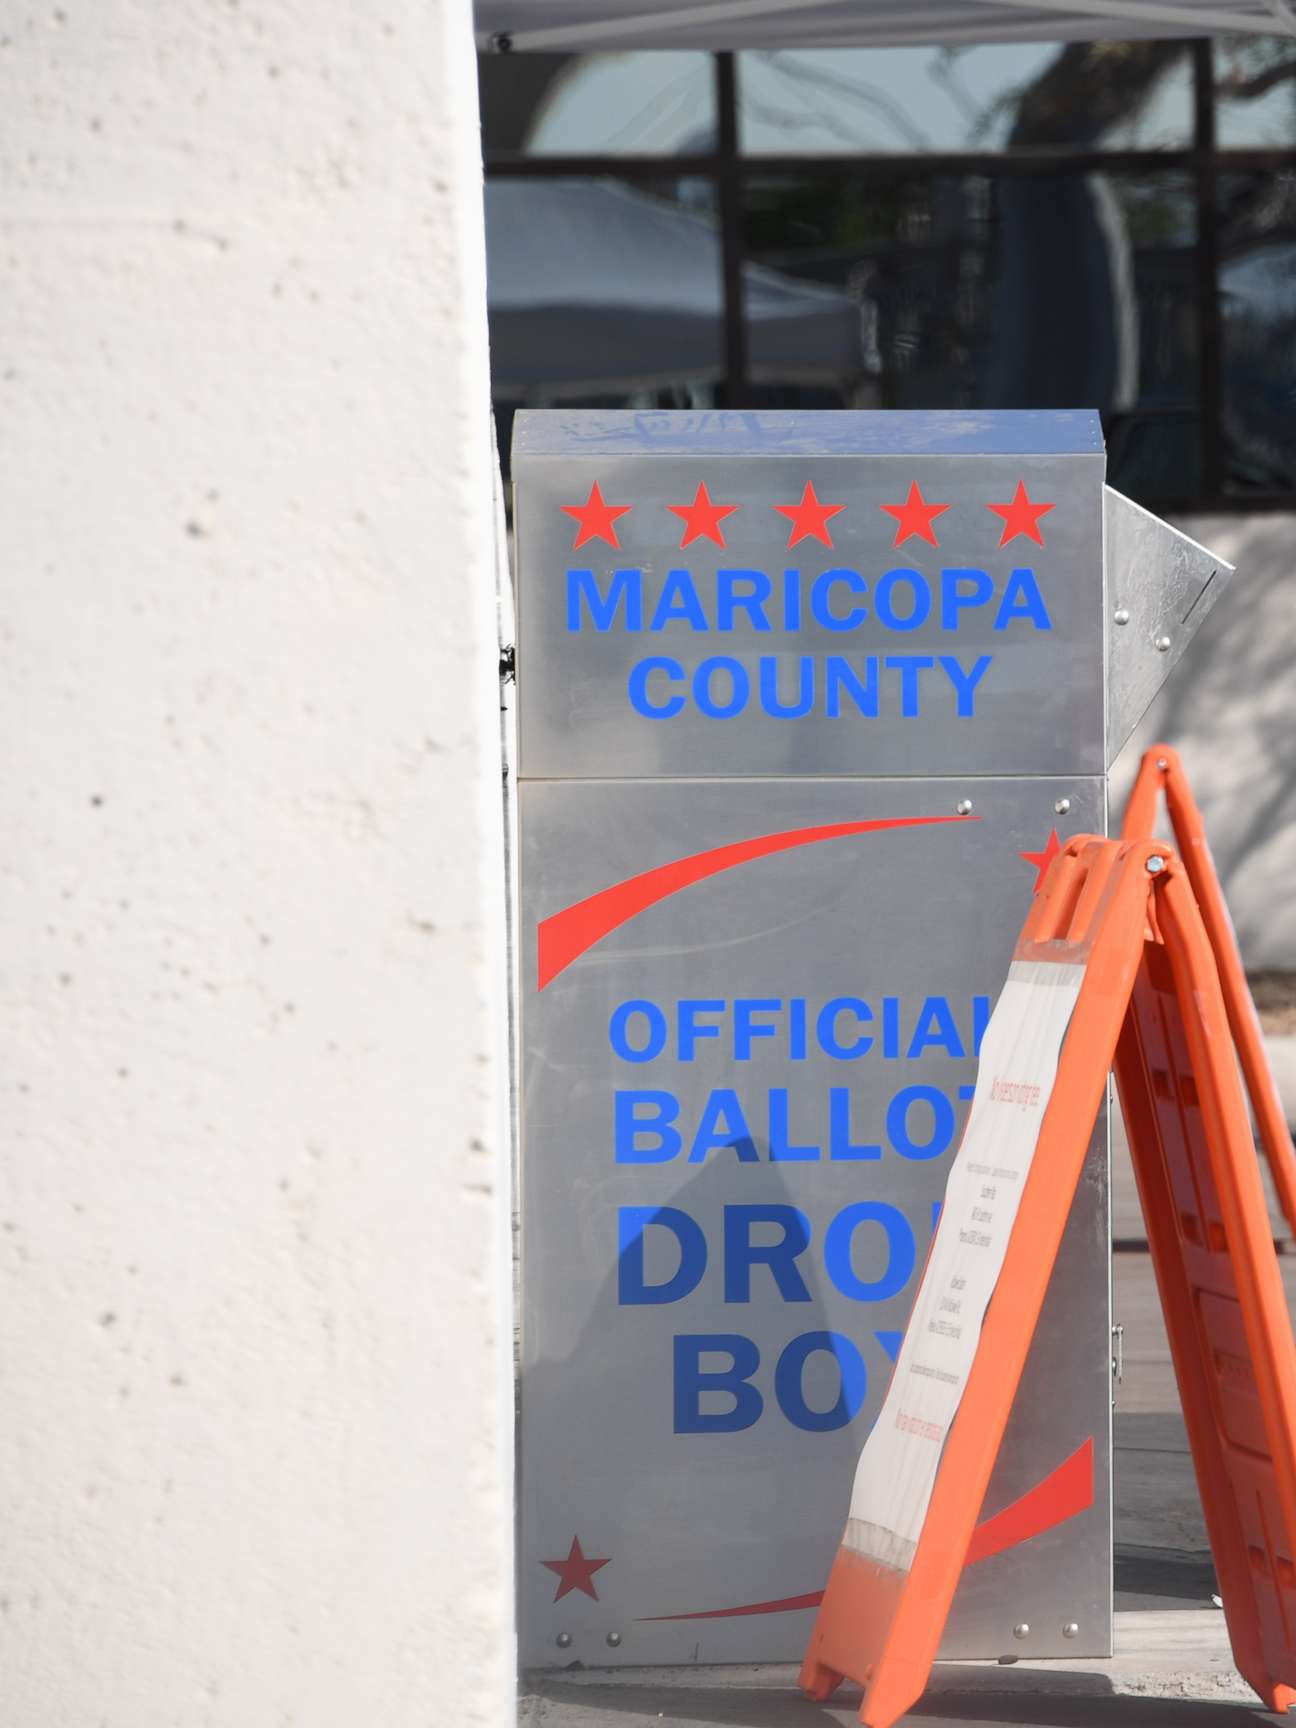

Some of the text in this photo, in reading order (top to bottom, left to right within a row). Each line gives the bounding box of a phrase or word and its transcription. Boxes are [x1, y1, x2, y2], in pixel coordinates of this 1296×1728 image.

[565, 567, 1053, 633] MARICOPA
[627, 655, 992, 720] COUNTY
[614, 1084, 976, 1165] BALLO
[617, 1200, 943, 1306] DRO
[673, 1330, 905, 1434] BO
